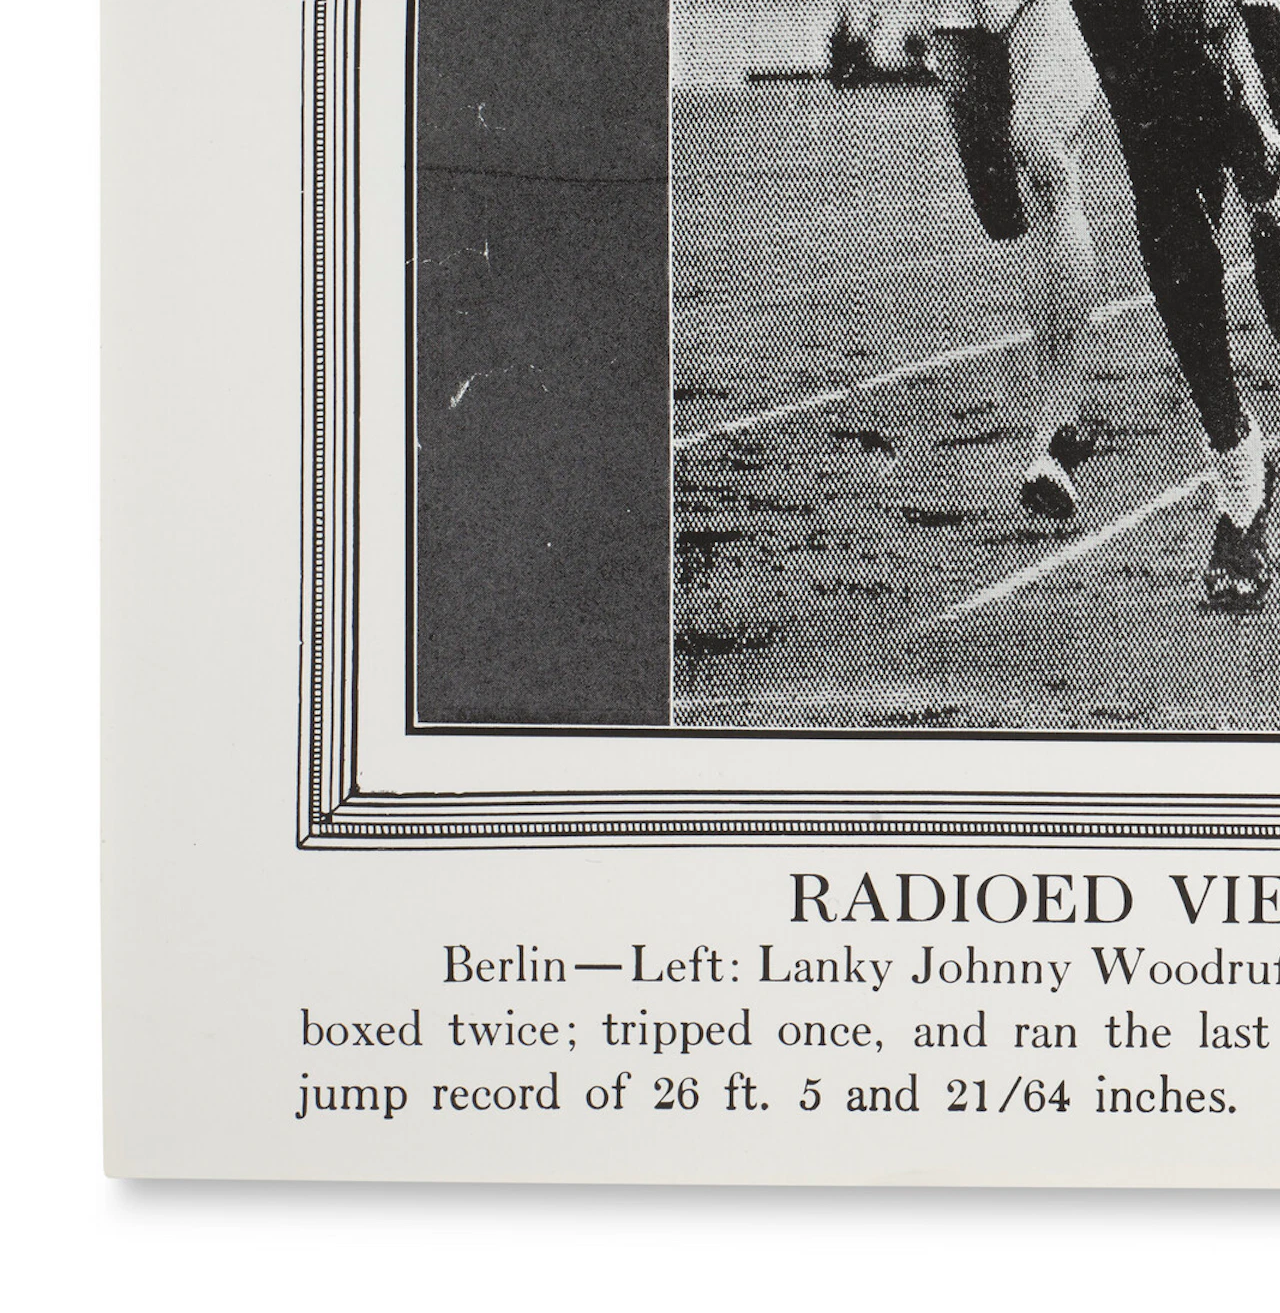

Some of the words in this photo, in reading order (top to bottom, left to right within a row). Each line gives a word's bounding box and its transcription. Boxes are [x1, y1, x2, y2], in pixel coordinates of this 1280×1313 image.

[789, 871, 1133, 924] RADIOED
[759, 944, 893, 992] Lanky
[911, 945, 1071, 993] Johnny
[300, 1008, 423, 1047] boxed
[448, 1009, 576, 1052] twice;
[601, 1008, 753, 1055] tripped
[778, 1022, 883, 1053] once,
[914, 1010, 988, 1048] and
[1014, 1024, 1077, 1049] ran
[1104, 1010, 1172, 1049] the
[1199, 1010, 1270, 1050] last
[294, 1072, 408, 1120] jump
[432, 1071, 561, 1111] record
[585, 1071, 632, 1110] of
[653, 1077, 699, 1110] 26
[724, 1071, 769, 1111] ft.
[799, 1078, 822, 1112] 5
[846, 1073, 920, 1112] and
[946, 1075, 1071, 1113] 21/64
[1095, 1073, 1237, 1114] inches.
